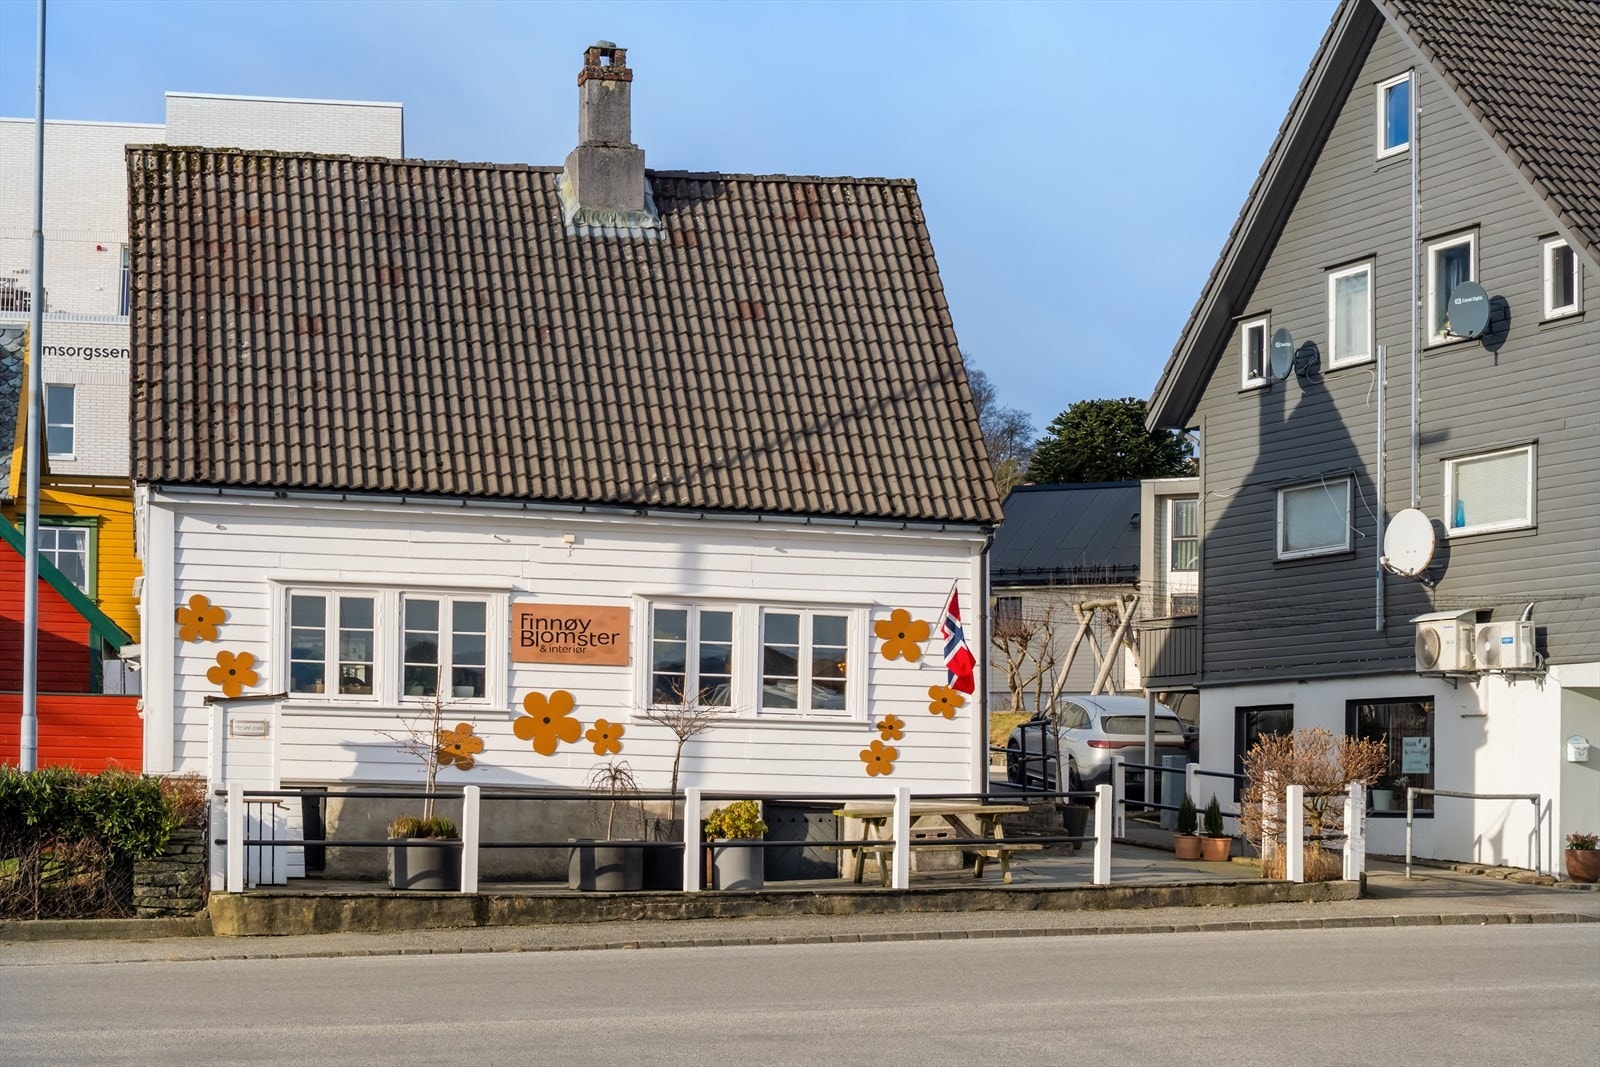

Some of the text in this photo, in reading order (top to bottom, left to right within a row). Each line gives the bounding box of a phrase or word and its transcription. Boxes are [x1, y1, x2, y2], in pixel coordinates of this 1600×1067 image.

[521, 613, 591, 633] Finnøy
[521, 630, 620, 647] Blomster
[540, 644, 587, 653] & interiør
